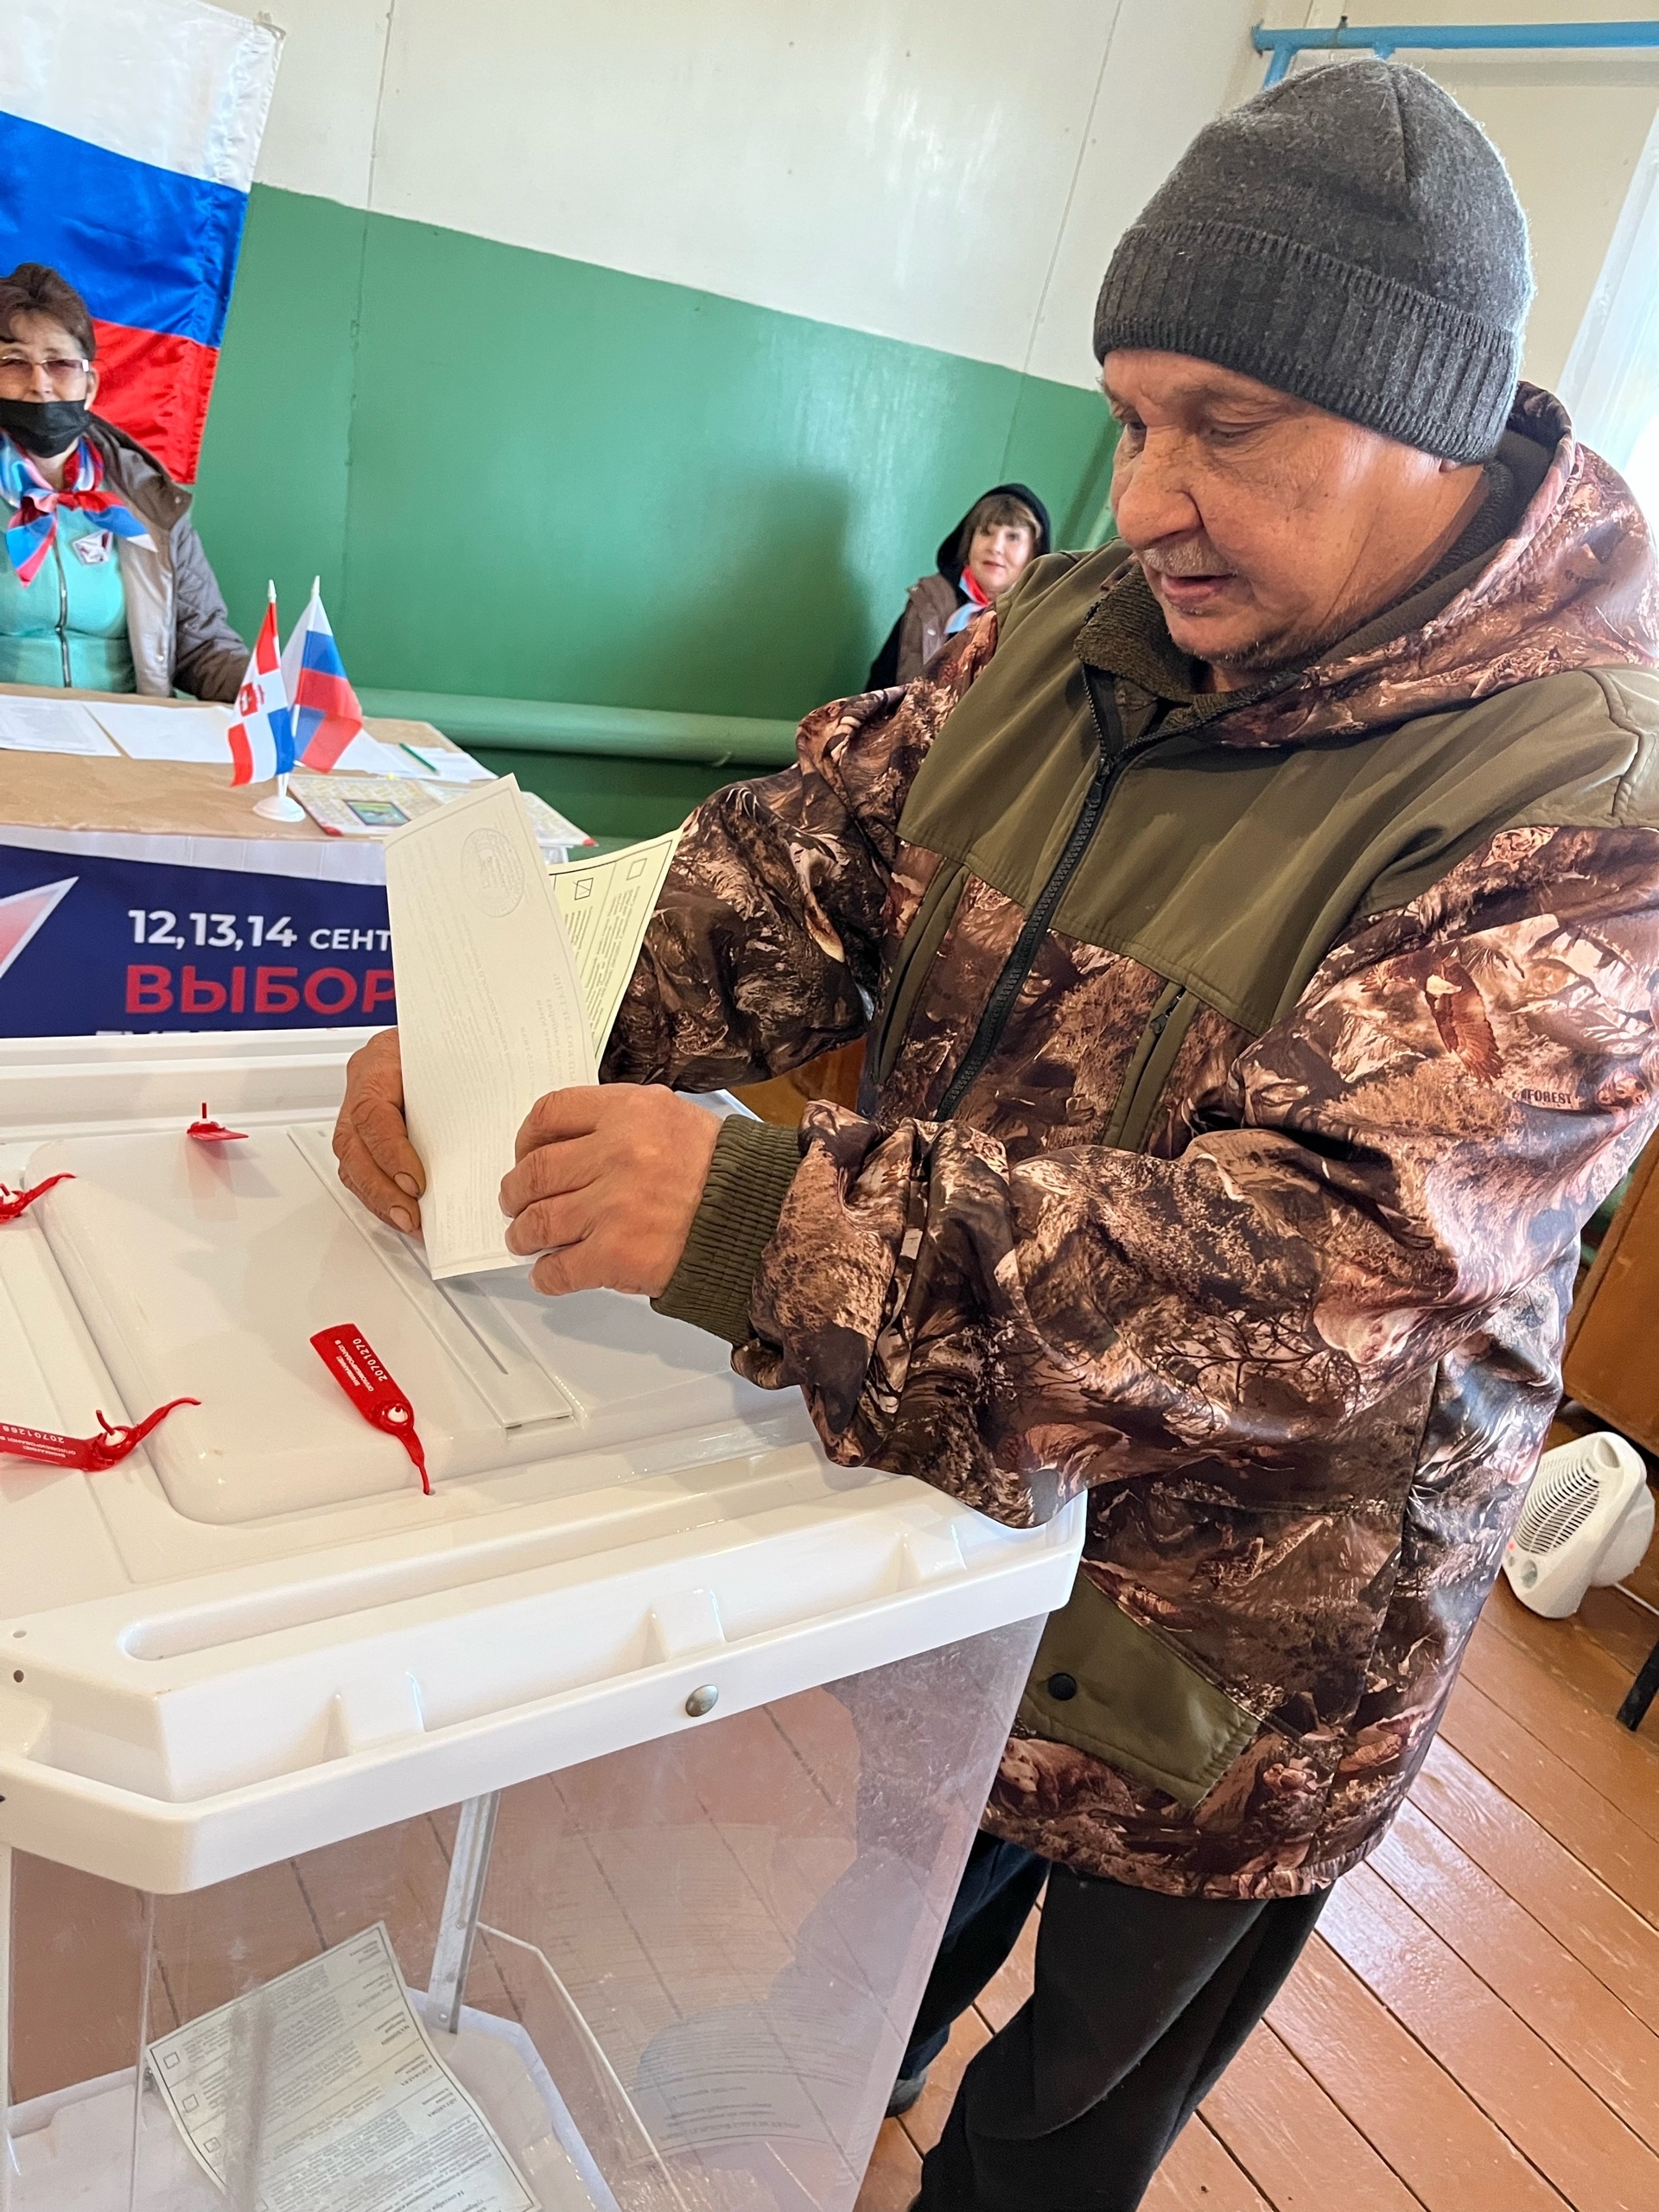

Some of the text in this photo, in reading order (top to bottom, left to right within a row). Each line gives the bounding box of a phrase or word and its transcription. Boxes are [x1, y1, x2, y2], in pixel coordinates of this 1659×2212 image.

[128, 909, 298, 951] 12,13,14
[124, 964, 395, 1014] ВЫБОР
[353, 1338, 388, 1382] 20701270
